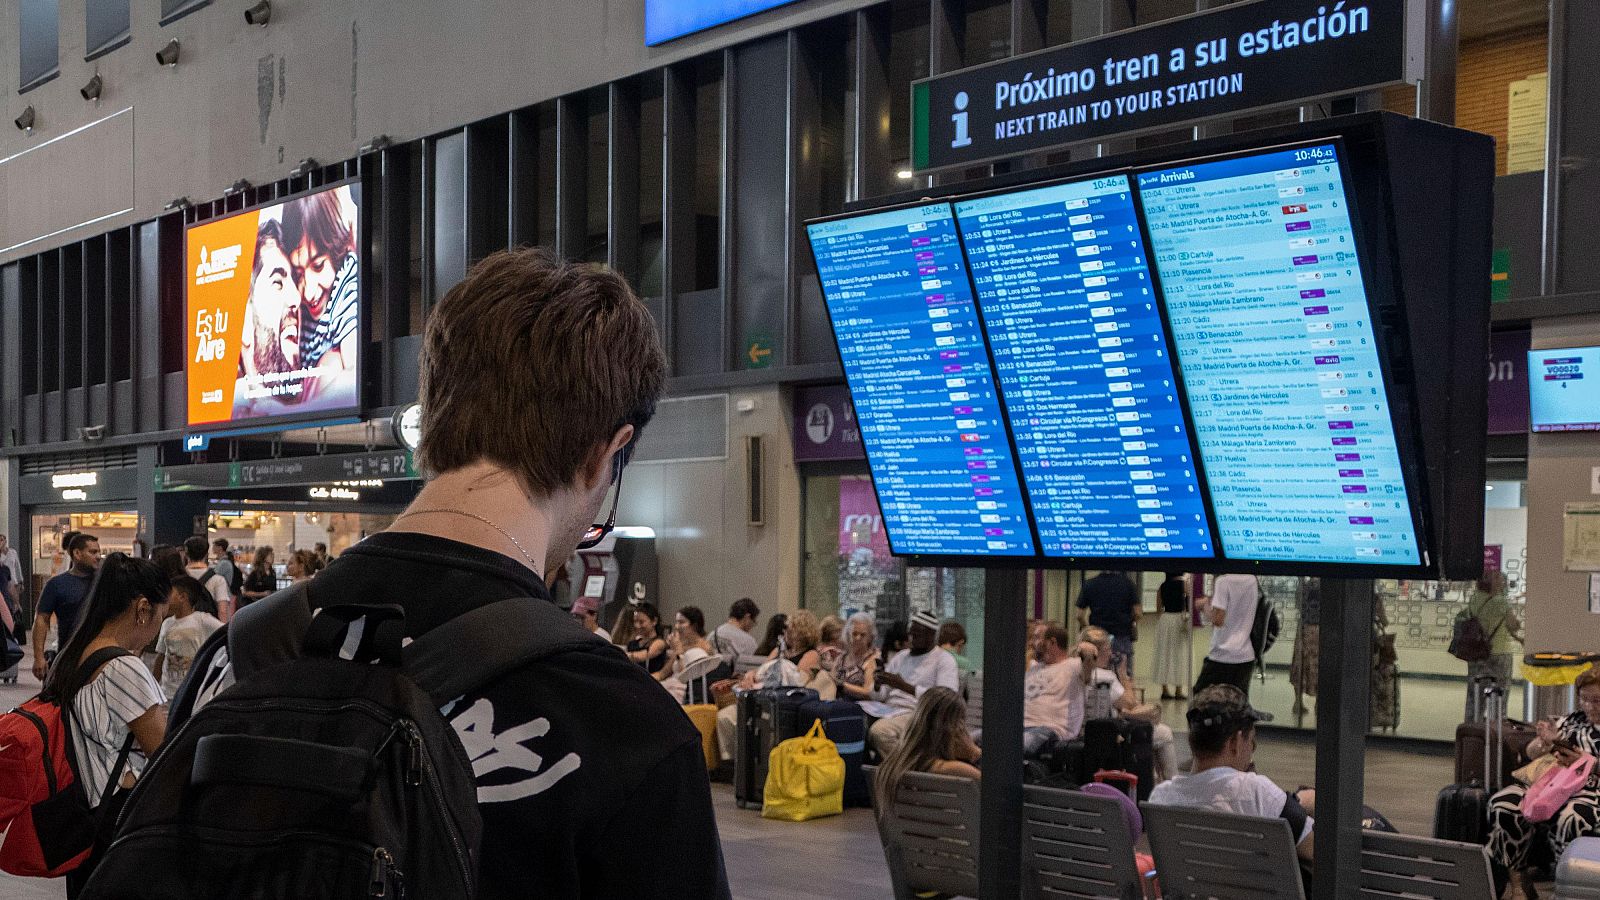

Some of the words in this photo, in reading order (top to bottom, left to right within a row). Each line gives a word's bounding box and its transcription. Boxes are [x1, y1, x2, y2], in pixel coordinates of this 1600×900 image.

[995, 68, 1096, 110] Próximo
[1102, 53, 1160, 87] tren
[1168, 47, 1186, 73] a
[1194, 37, 1228, 68] su
[1238, 1, 1369, 58] estación
[995, 115, 1035, 140] NEXT
[1037, 104, 1087, 132] TRAIN
[1090, 99, 1112, 121] TO
[1115, 89, 1162, 116] YOUR
[1166, 72, 1243, 107] STATION
[1142, 189, 1162, 198] 10:04
[1174, 184, 1196, 194] Utrera
[1323, 164, 1331, 173] 9
[1158, 168, 1195, 183] Arrivals
[1146, 205, 1166, 214] 10:34
[1178, 200, 1200, 210] Utrera
[988, 212, 1002, 221] Lora
[1150, 221, 1170, 231] 10:46
[1170, 218, 1193, 228] Madrid
[1193, 215, 1215, 225] Puerta
[1215, 214, 1224, 222] de
[1224, 210, 1260, 221] Atocha-A.
[1259, 208, 1270, 217] Gr.
[1331, 200, 1338, 208] 6
[992, 226, 1011, 236] Utrera
[995, 242, 1015, 251] Utrera
[1157, 254, 1177, 262] 11:00
[1189, 249, 1214, 260] Cartuja
[1161, 270, 1181, 278] 11:10
[1181, 266, 1211, 276] Plasencia
[1165, 285, 1184, 294] 11:13
[1196, 282, 1212, 291] Lora
[1169, 301, 1188, 310] 11:19
[1230, 294, 1265, 304] Zambrano
[195, 308, 213, 337] Es
[214, 307, 229, 334] tu
[1355, 320, 1363, 328] 9
[194, 335, 226, 363] Aire
[1211, 346, 1232, 354] Utrera
[1256, 358, 1291, 366] Atocha-A.
[393, 455, 406, 473] P2
